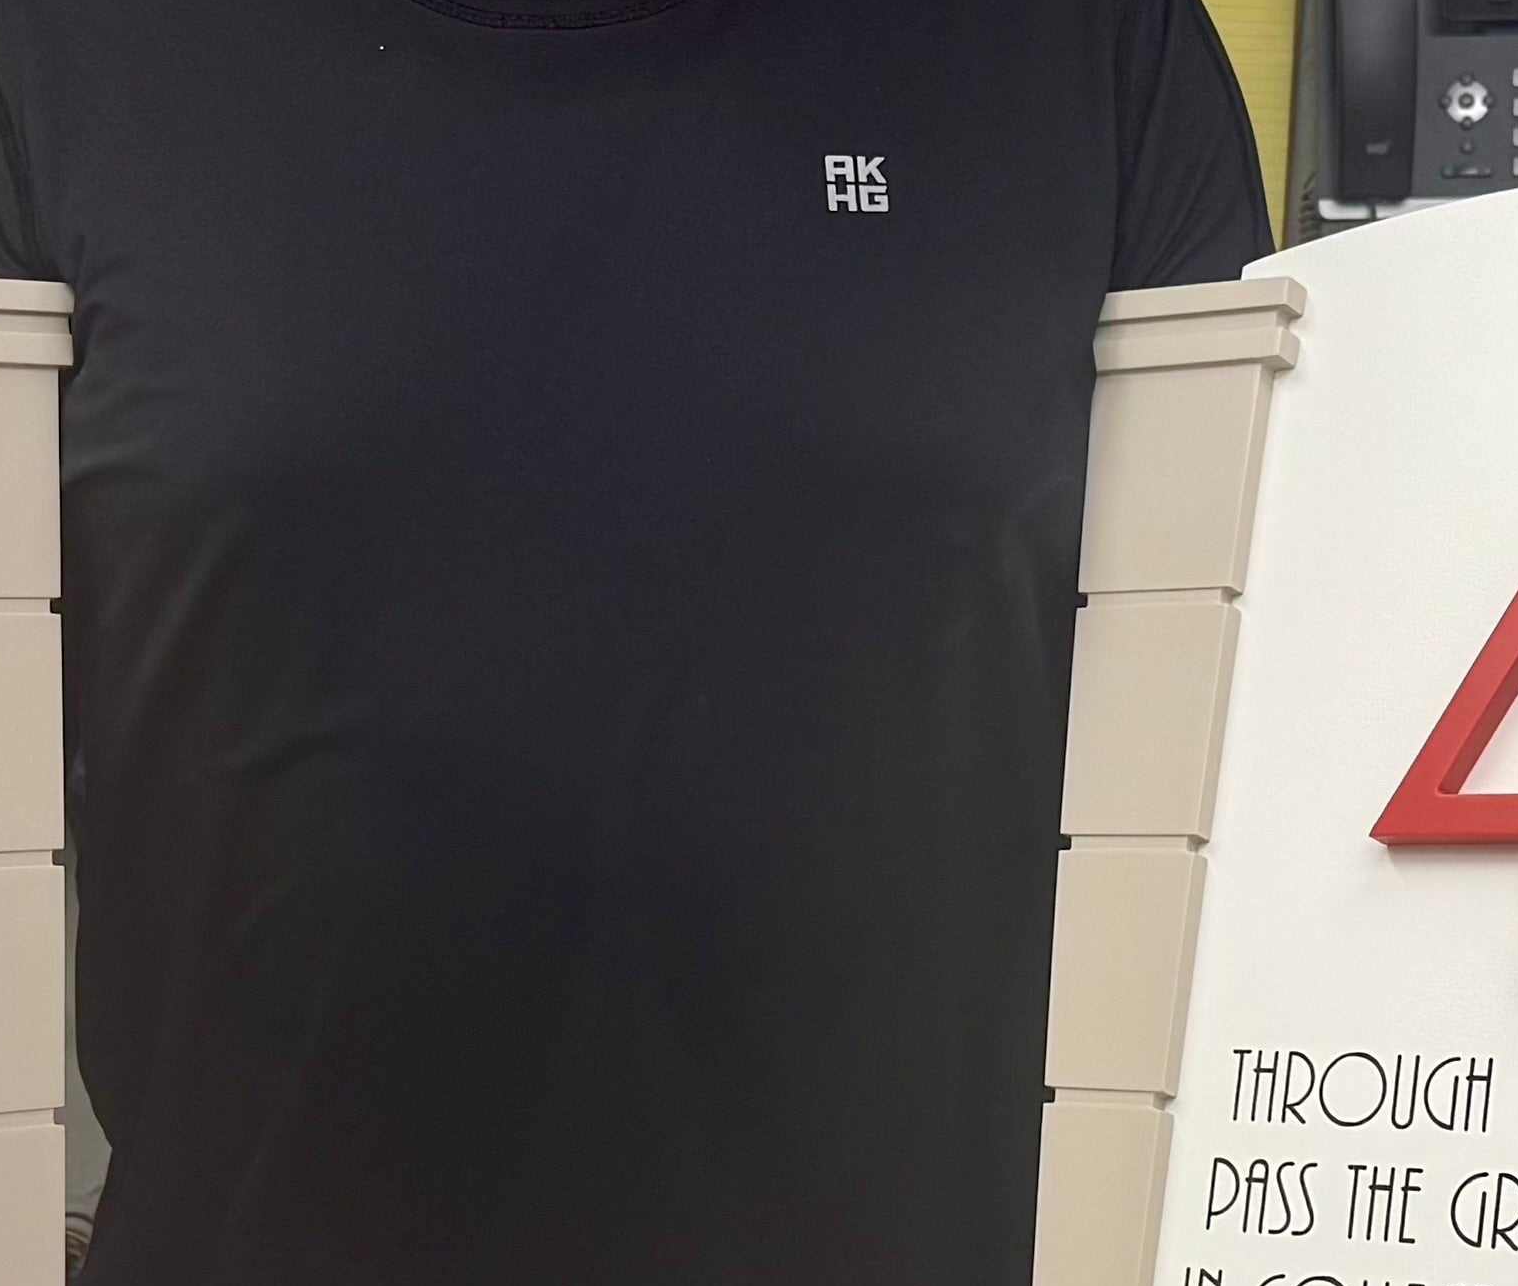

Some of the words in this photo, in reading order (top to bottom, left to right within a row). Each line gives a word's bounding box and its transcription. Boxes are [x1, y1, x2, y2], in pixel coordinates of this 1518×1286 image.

[1233, 1049, 1493, 1133] THROUGH
[1206, 1157, 1318, 1236] PASS
[1348, 1165, 1424, 1244] THE
